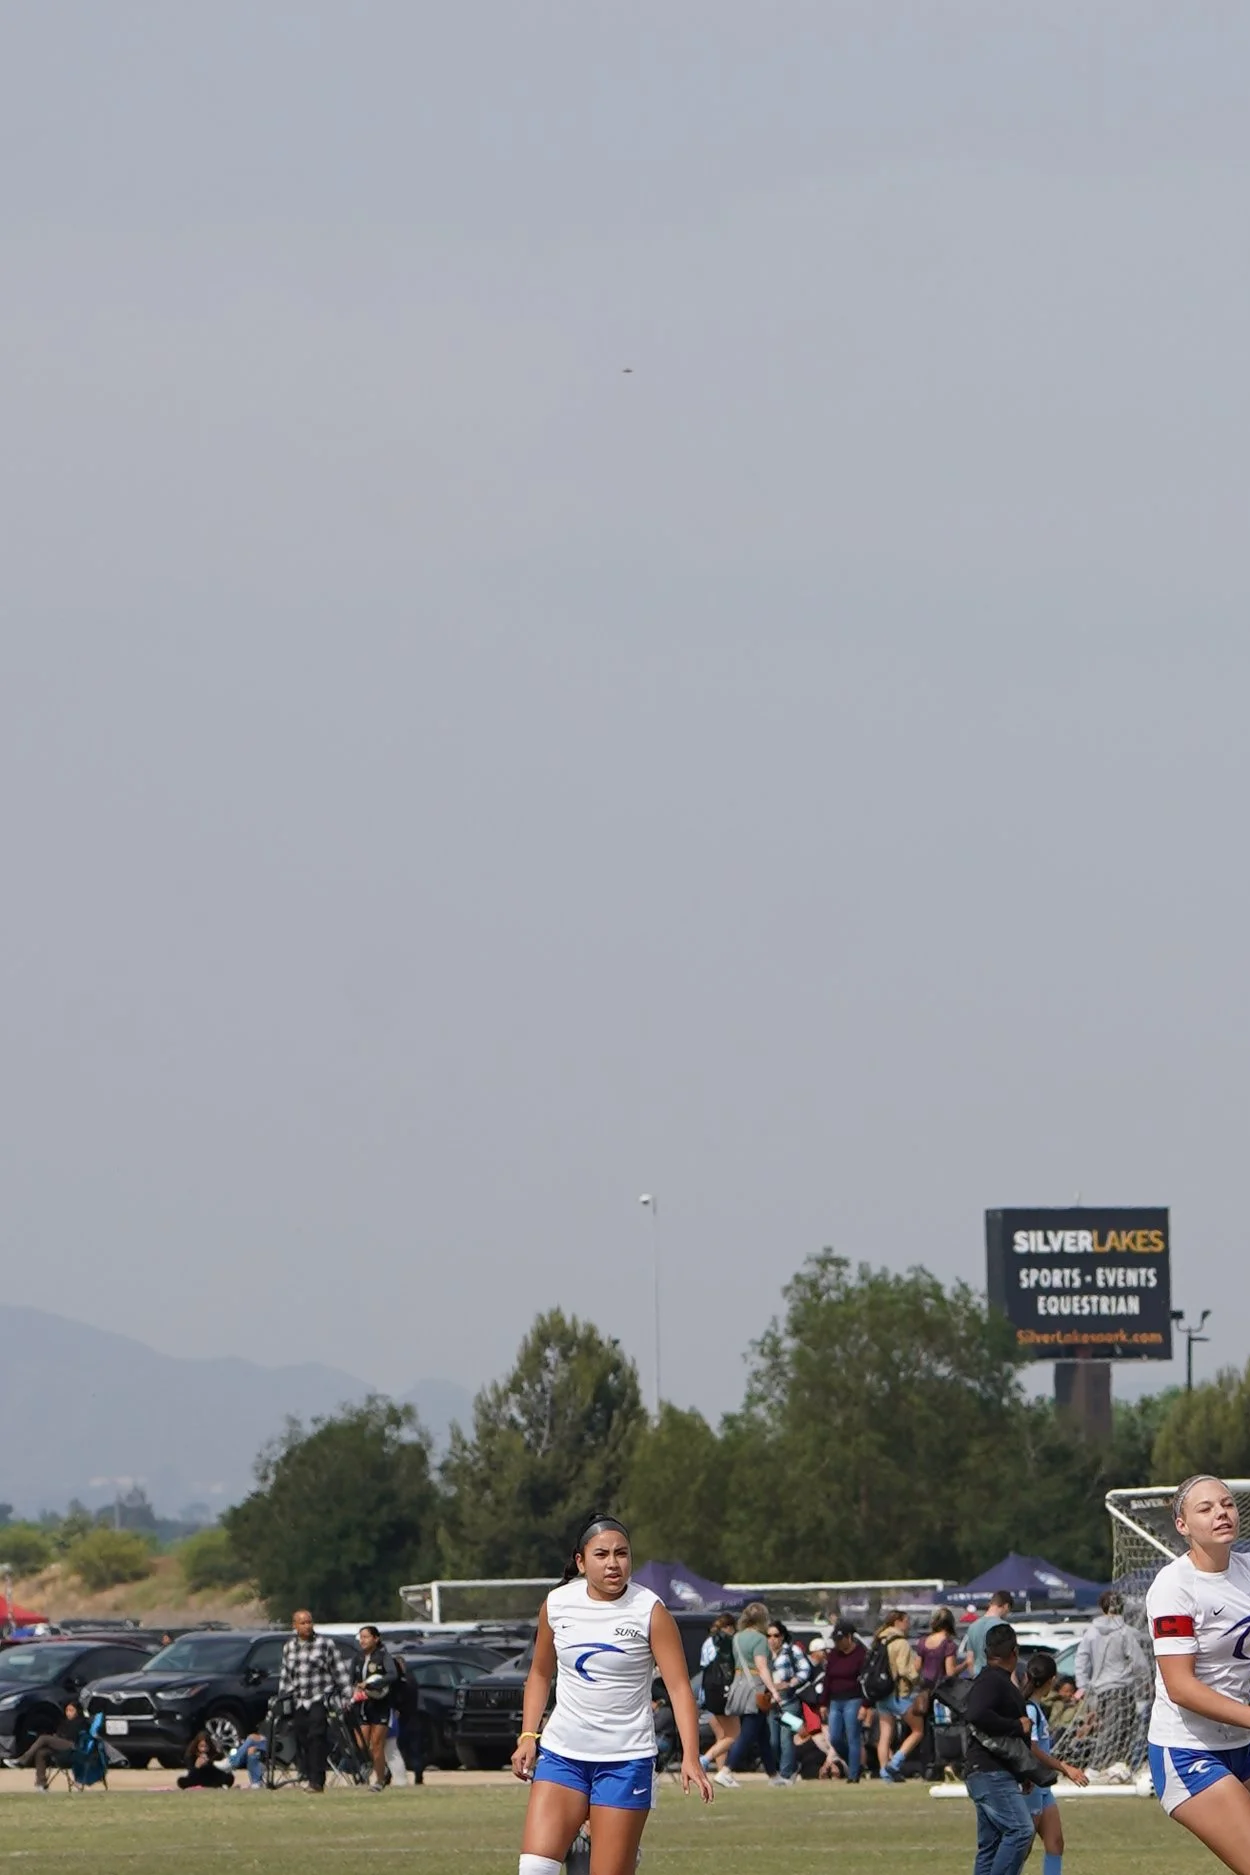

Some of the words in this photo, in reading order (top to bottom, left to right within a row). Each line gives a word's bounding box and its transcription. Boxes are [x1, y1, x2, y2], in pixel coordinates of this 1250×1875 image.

[1013, 1229, 1165, 1253] SILVERLAKES
[1019, 1267, 1081, 1289] SPORTS
[1096, 1267, 1158, 1288] EVENTS
[1037, 1295, 1140, 1316] EQUESTRIAN
[613, 1627, 642, 1638] SURF
[1157, 1617, 1178, 1635] C
